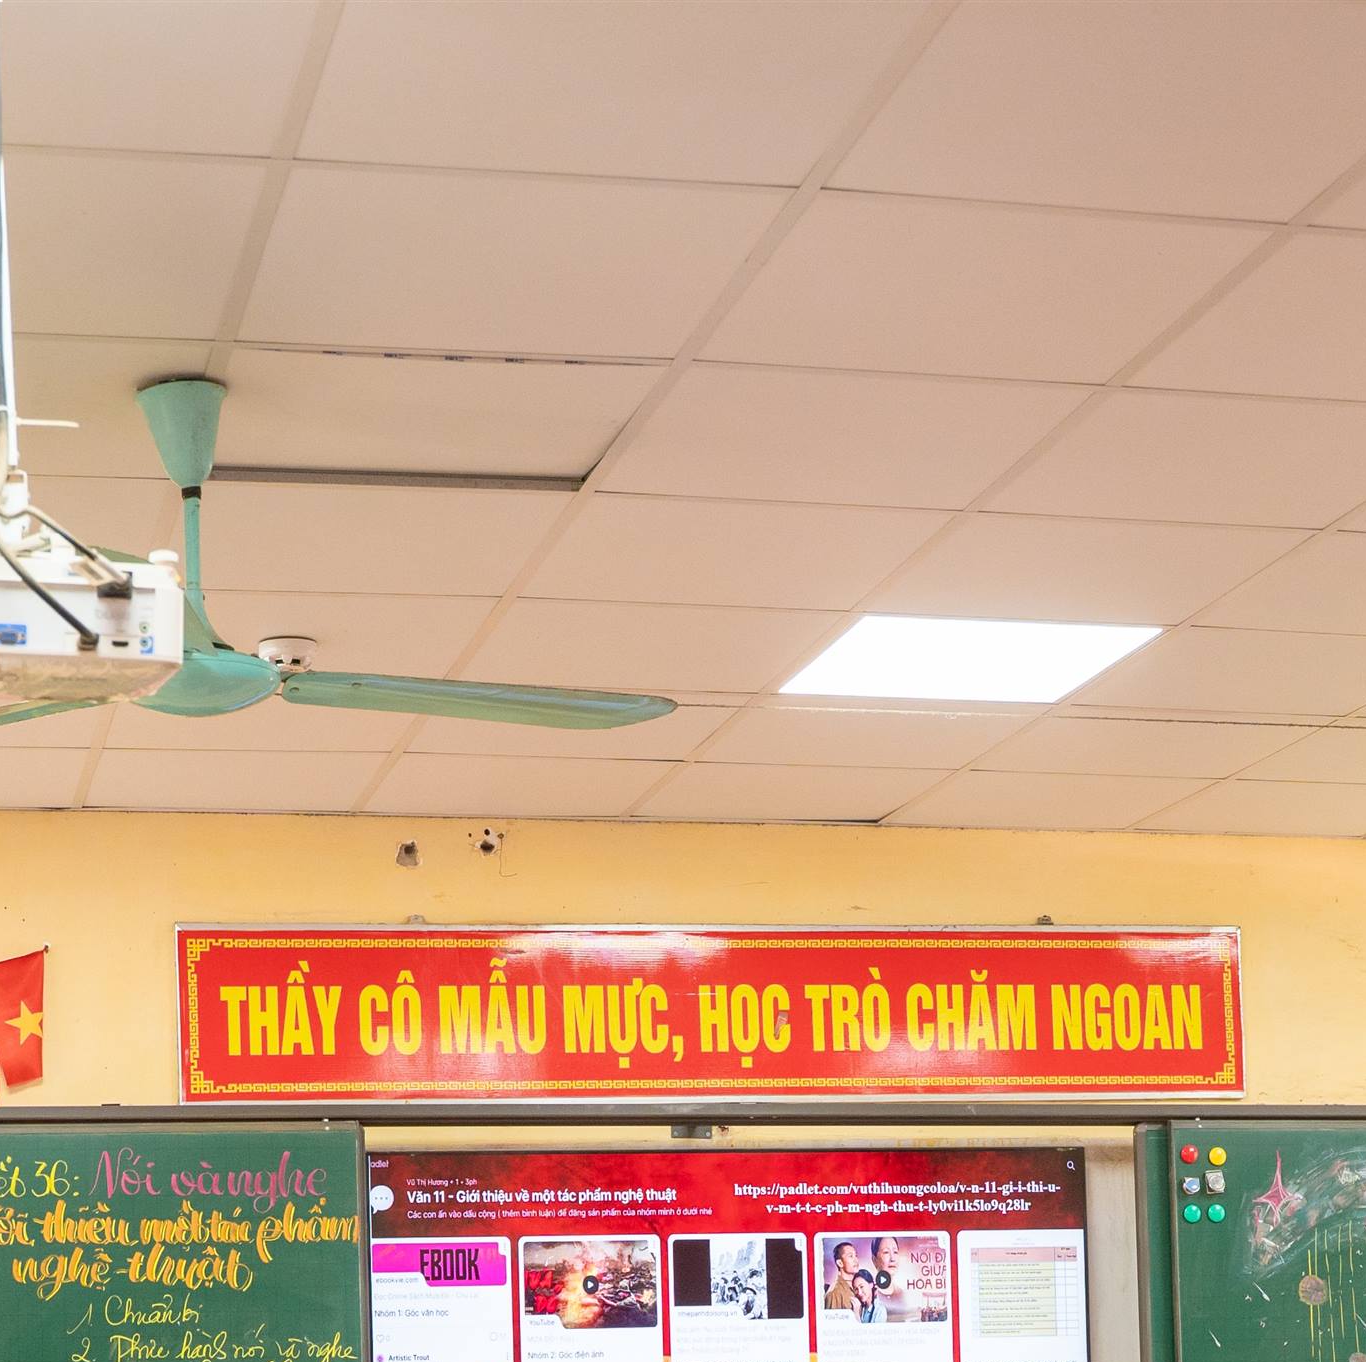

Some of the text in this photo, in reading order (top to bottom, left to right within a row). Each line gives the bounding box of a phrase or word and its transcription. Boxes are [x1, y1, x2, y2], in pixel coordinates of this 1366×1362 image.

[220, 957, 1202, 1068] THẦY CÔ MẪU MỰC, HỌC TRÒ CHĂM NGOAN
[31, 1160, 80, 1197] 36:
[88, 1147, 161, 1199] Nói
[171, 1161, 224, 1196] và
[227, 1151, 326, 1214] nghe
[406, 1187, 677, 1205] Văn 11 Giới thiệu về một tác phẩm nghệ thuật
[257, 1197, 360, 1264] phẩm
[12, 1243, 254, 1301] nghệ thuật
[419, 1248, 481, 1281] EBOOK
[232, 1323, 265, 1358] nói
